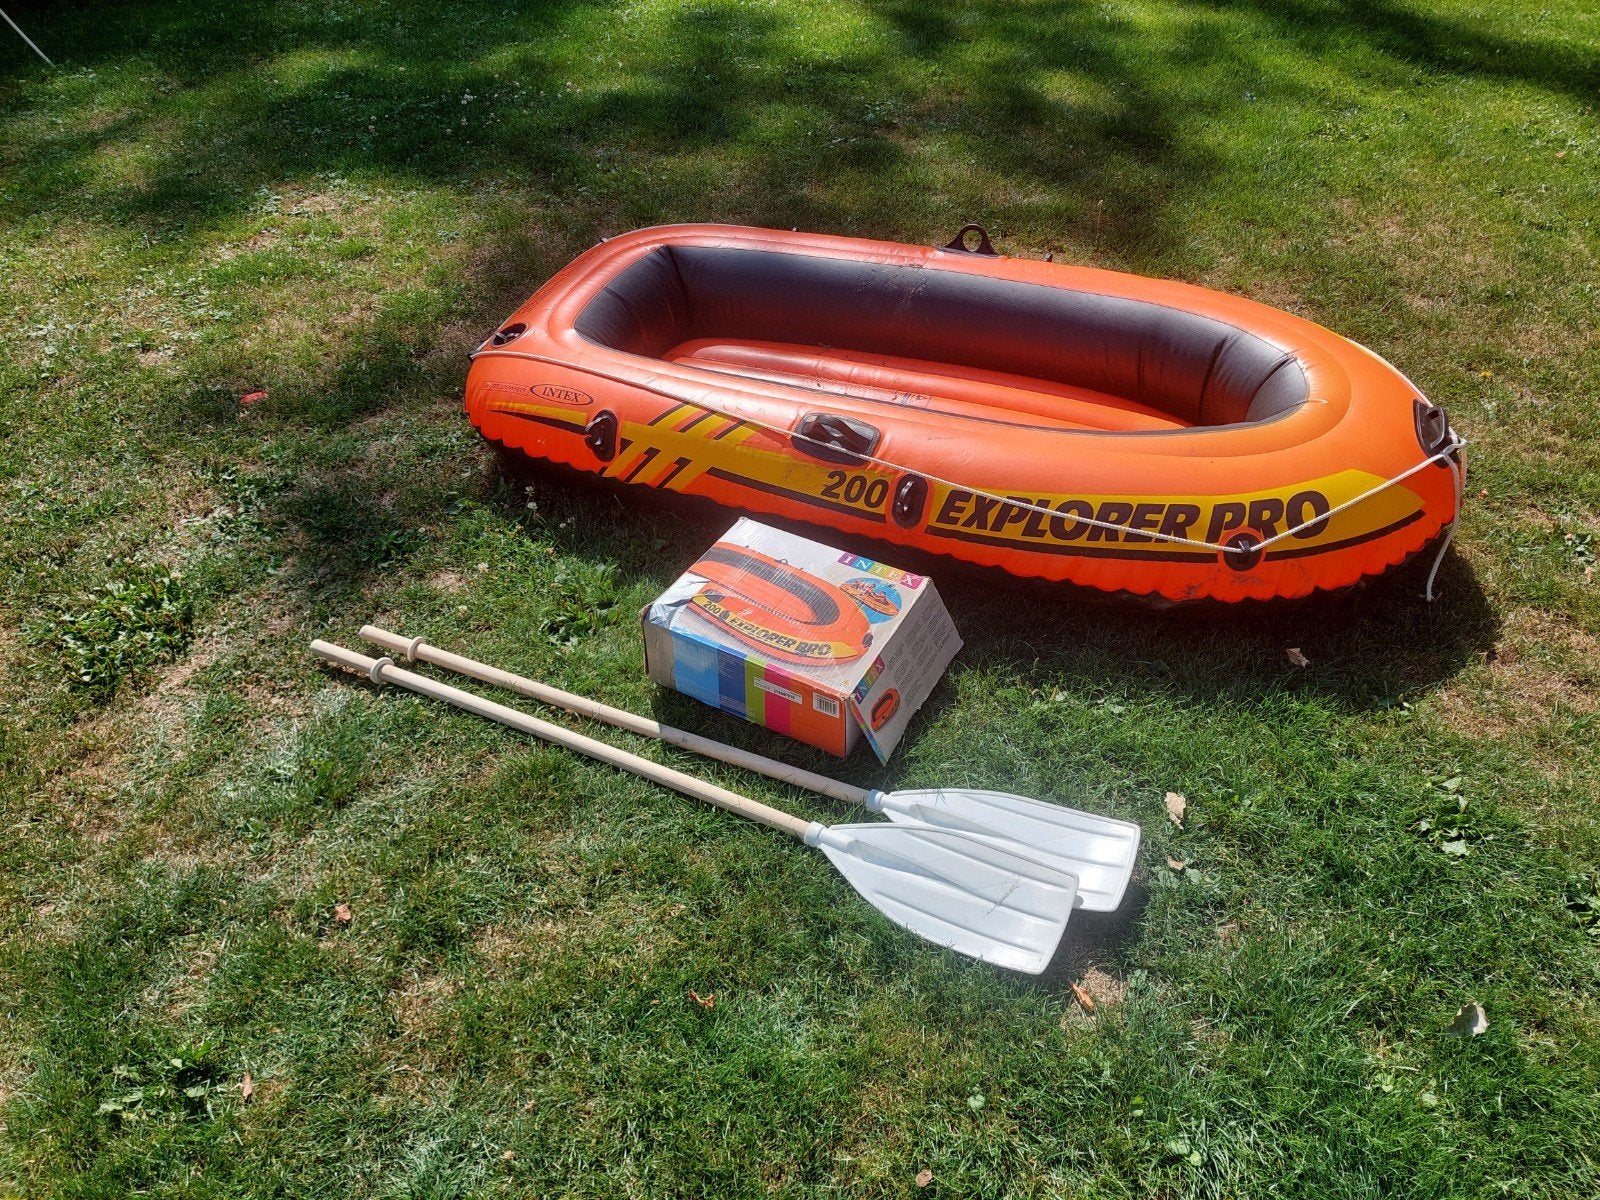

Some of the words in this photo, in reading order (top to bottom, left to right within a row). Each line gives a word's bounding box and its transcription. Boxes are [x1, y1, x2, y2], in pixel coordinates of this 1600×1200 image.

[542, 386, 582, 403] INTEX
[820, 470, 889, 509] 200
[935, 489, 1201, 544] EXPLORER
[1205, 490, 1331, 543] PRO
[842, 555, 923, 586] INTEX
[702, 600, 721, 615] 200
[729, 616, 797, 650] EXPLORER
